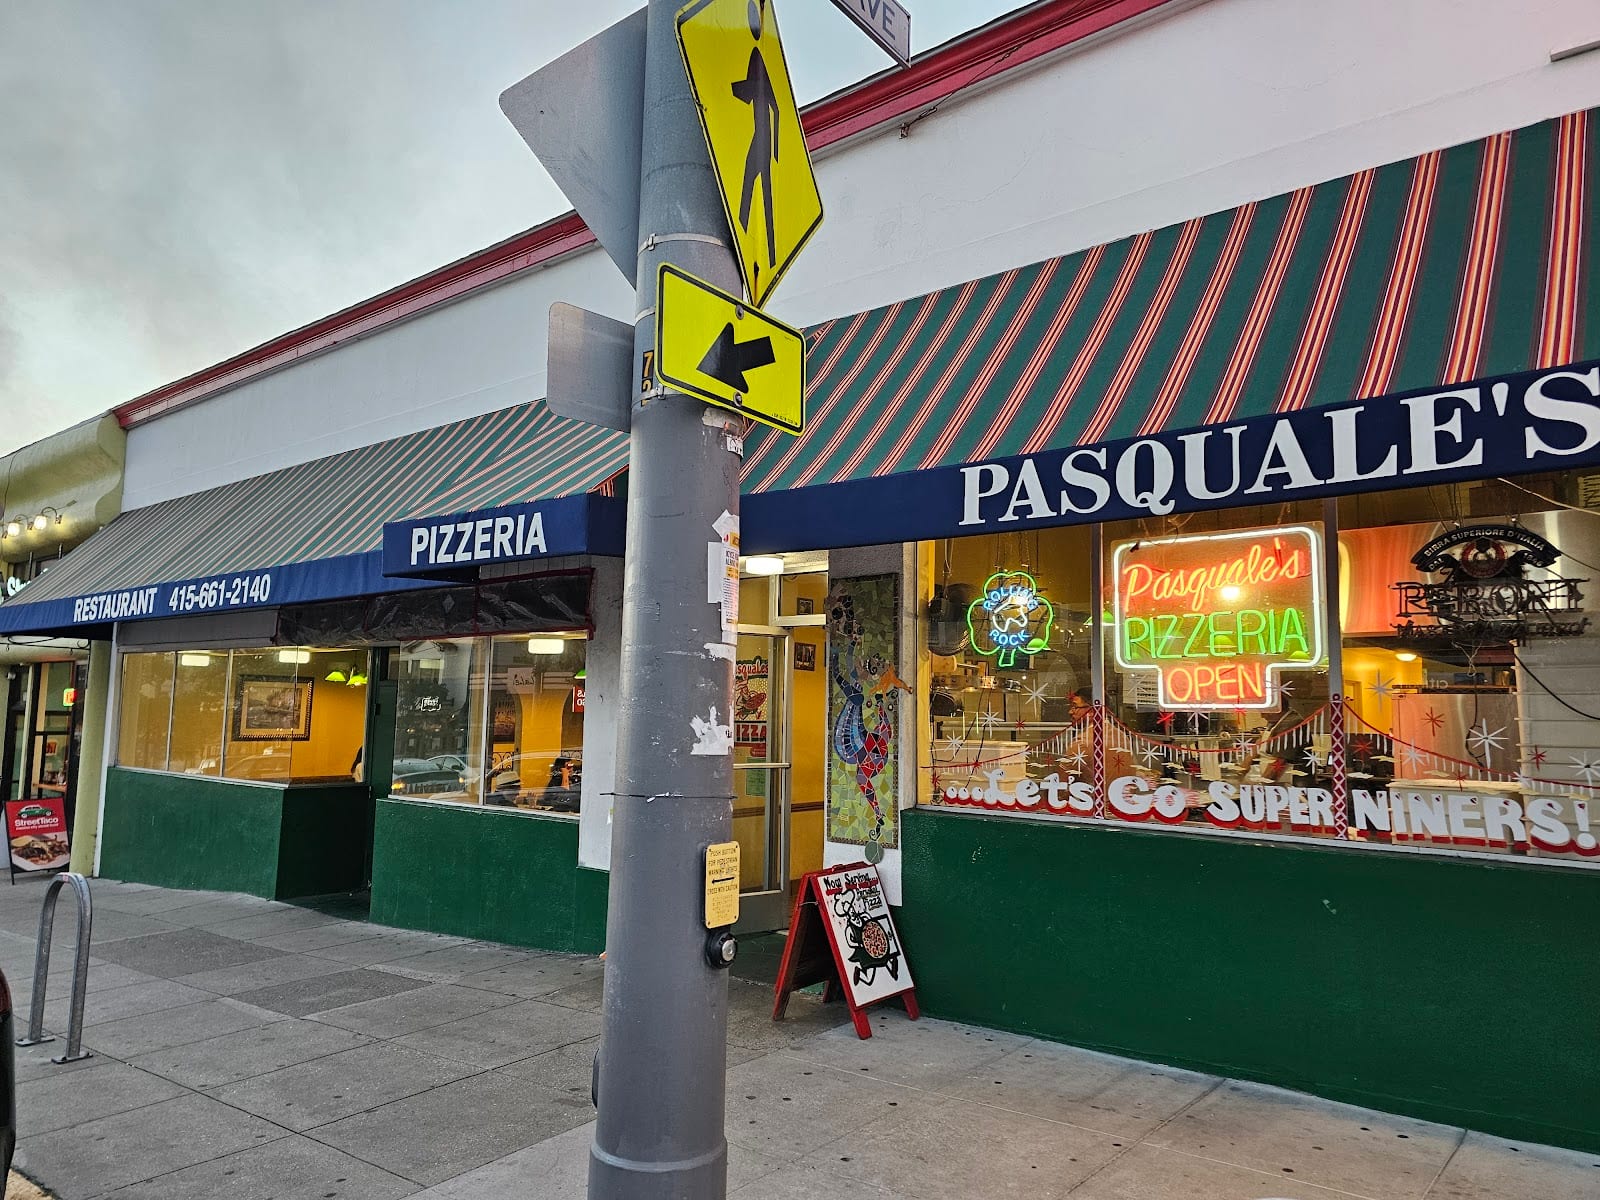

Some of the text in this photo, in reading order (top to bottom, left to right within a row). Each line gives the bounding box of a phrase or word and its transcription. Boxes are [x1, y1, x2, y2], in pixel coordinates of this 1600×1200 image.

[859, 0, 897, 41] VE
[958, 371, 1600, 526] PASQUALE'S
[410, 512, 547, 566] PIZZERIA
[1424, 529, 1545, 557] BIRRA SUPERIORE D'ITALIA
[1122, 538, 1300, 612] Pasquale's
[73, 574, 271, 623] RESTAURANT 415-661-2140
[983, 586, 1039, 611] ROLLING
[989, 629, 1030, 646] ROCK
[1124, 608, 1309, 661] PIZZERIA
[1166, 662, 1263, 702] OPEN
[736, 724, 768, 740] IZZA
[1108, 775, 1188, 821] Go
[1205, 781, 1335, 827] SUPER
[1351, 789, 1598, 850] NINERS!
